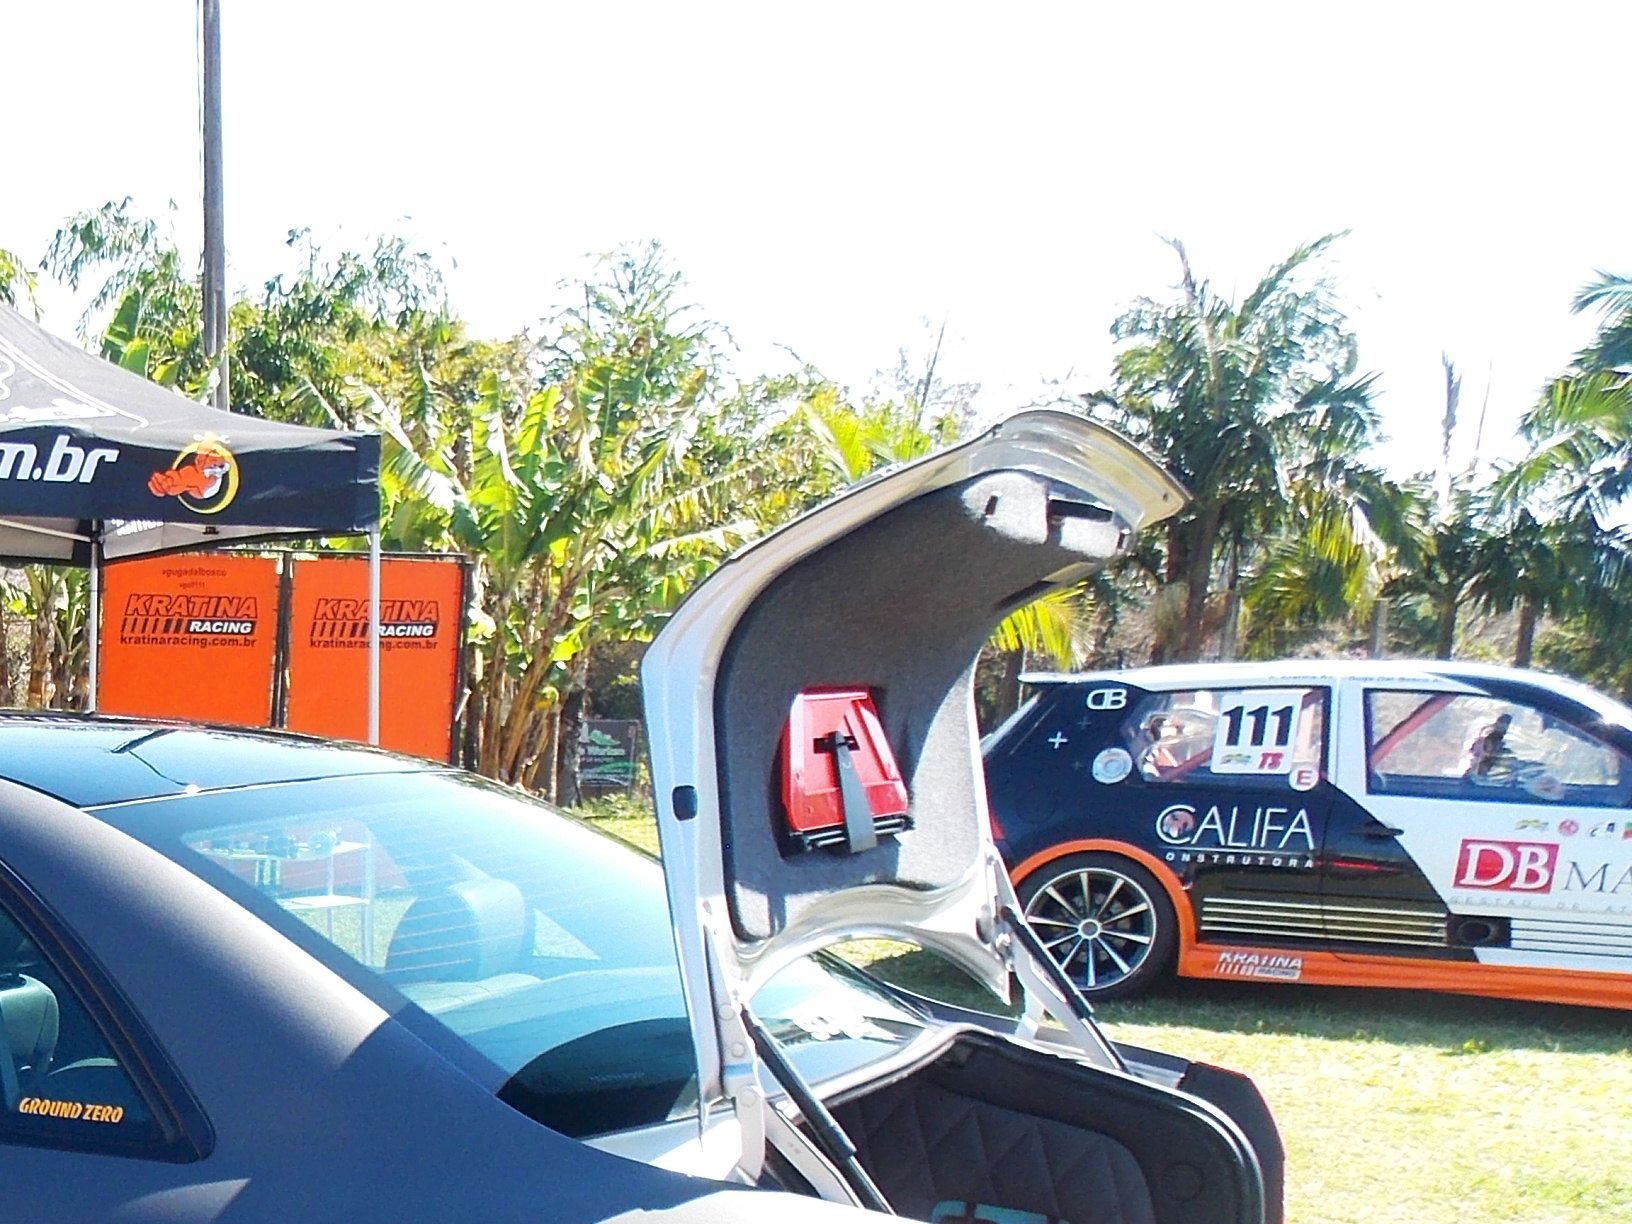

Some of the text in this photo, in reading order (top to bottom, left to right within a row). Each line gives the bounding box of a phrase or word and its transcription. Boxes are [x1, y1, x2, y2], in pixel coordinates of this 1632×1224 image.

[125, 593, 258, 618] KRATINA
[313, 597, 440, 622] KRATINA
[189, 621, 252, 634] RACING
[379, 625, 434, 637] RACING
[120, 634, 257, 648] kratinaracing.com.br
[310, 638, 438, 650] kratinaracng.com.br
[1222, 705, 1294, 747] 111
[1296, 770, 1312, 786] E
[1155, 804, 1315, 850] CALIFA
[1165, 852, 1314, 868] ONSTRUTORA
[1459, 843, 1550, 890] DB
[19, 1097, 124, 1123] GROUND ZERO
